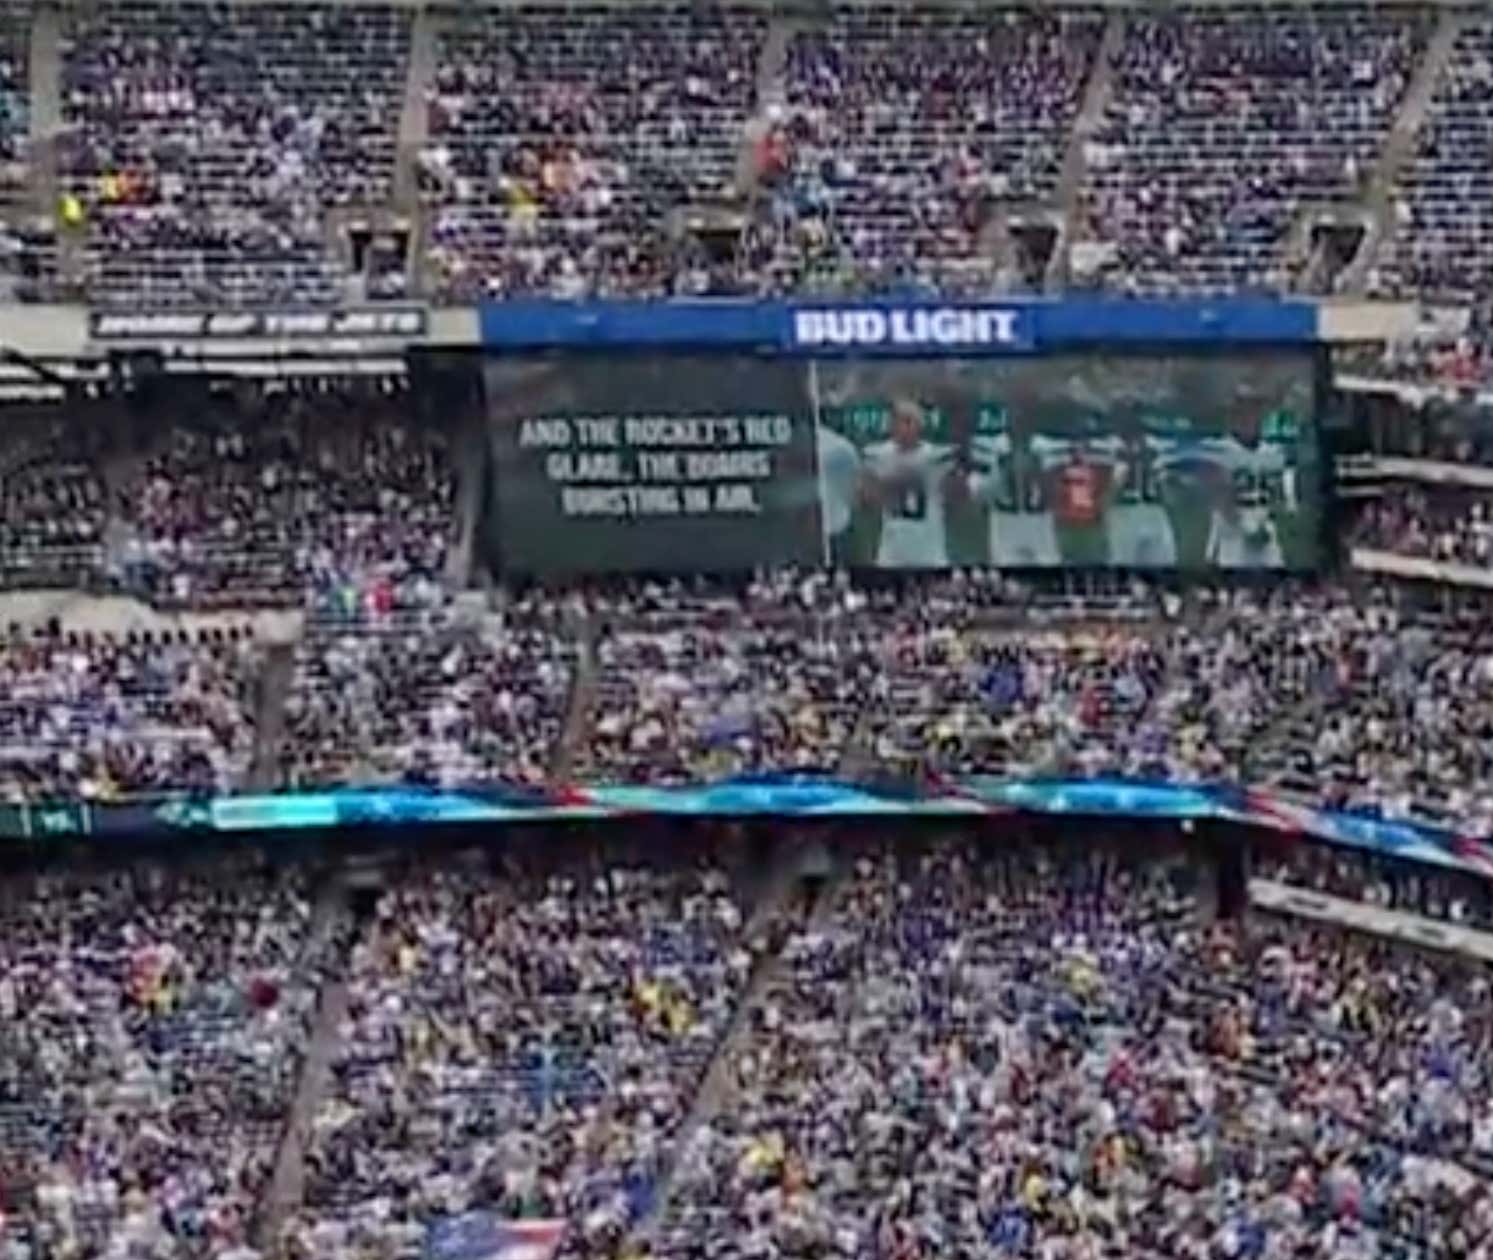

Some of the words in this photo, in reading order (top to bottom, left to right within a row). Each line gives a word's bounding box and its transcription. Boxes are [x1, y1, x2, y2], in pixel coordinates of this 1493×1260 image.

[796, 309, 887, 342] BUD
[891, 309, 1019, 342] LIGHT
[519, 415, 570, 446] AND
[573, 415, 620, 445] THE
[744, 415, 793, 445] RED
